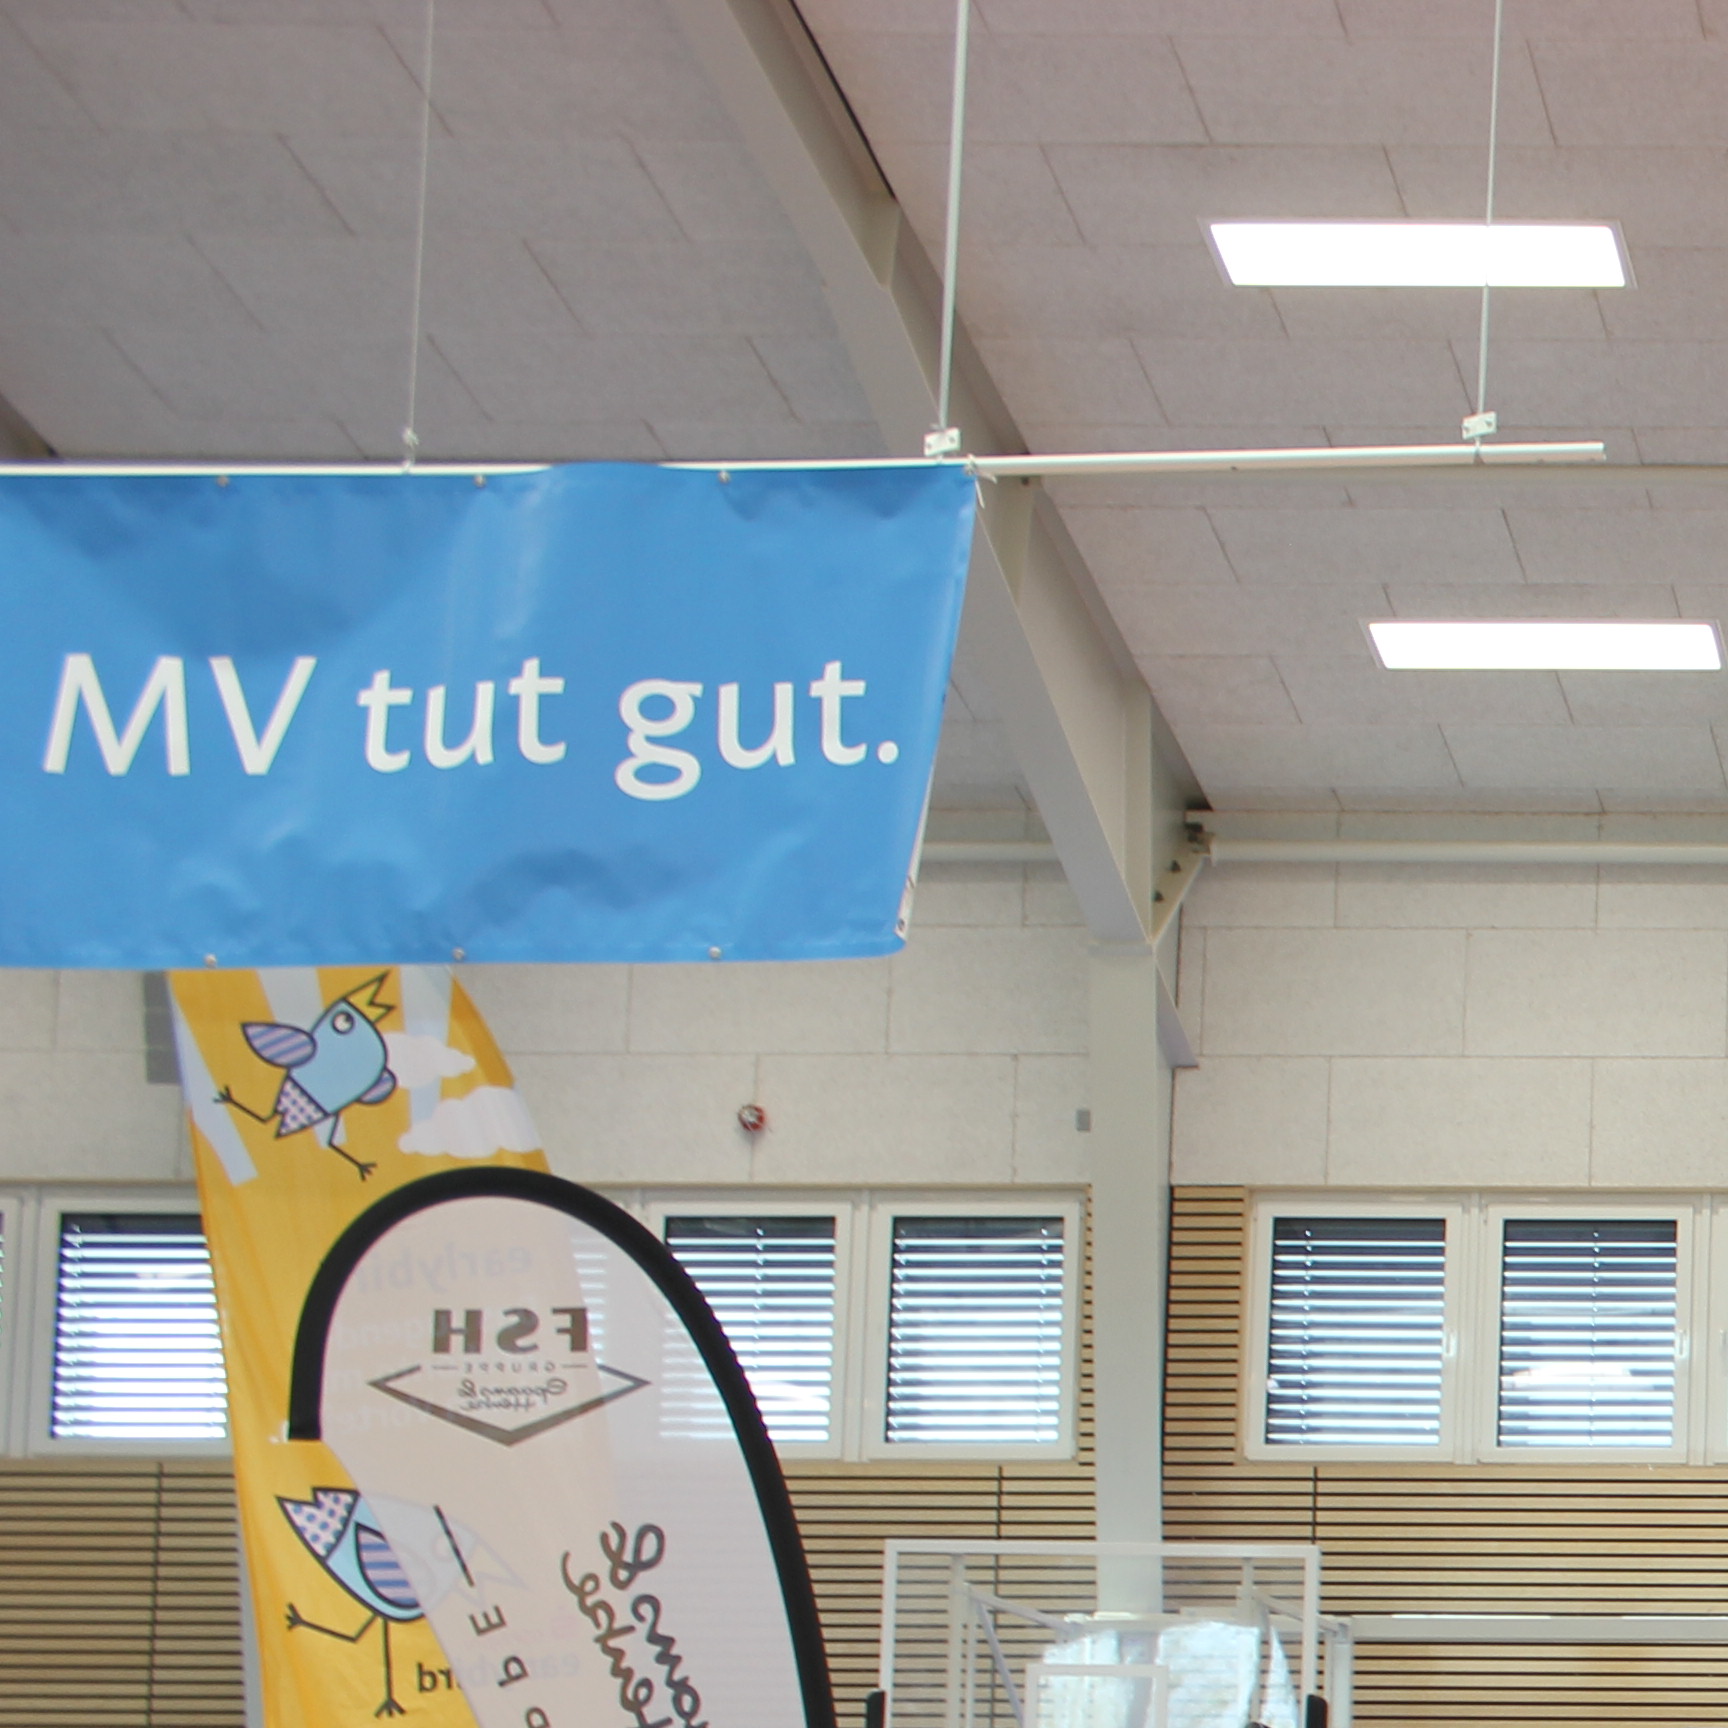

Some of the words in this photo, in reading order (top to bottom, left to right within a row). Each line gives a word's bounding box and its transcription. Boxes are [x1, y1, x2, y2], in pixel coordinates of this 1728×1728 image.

[43, 652, 317, 777] MV
[357, 657, 567, 773] tut
[614, 660, 899, 801] gut.
